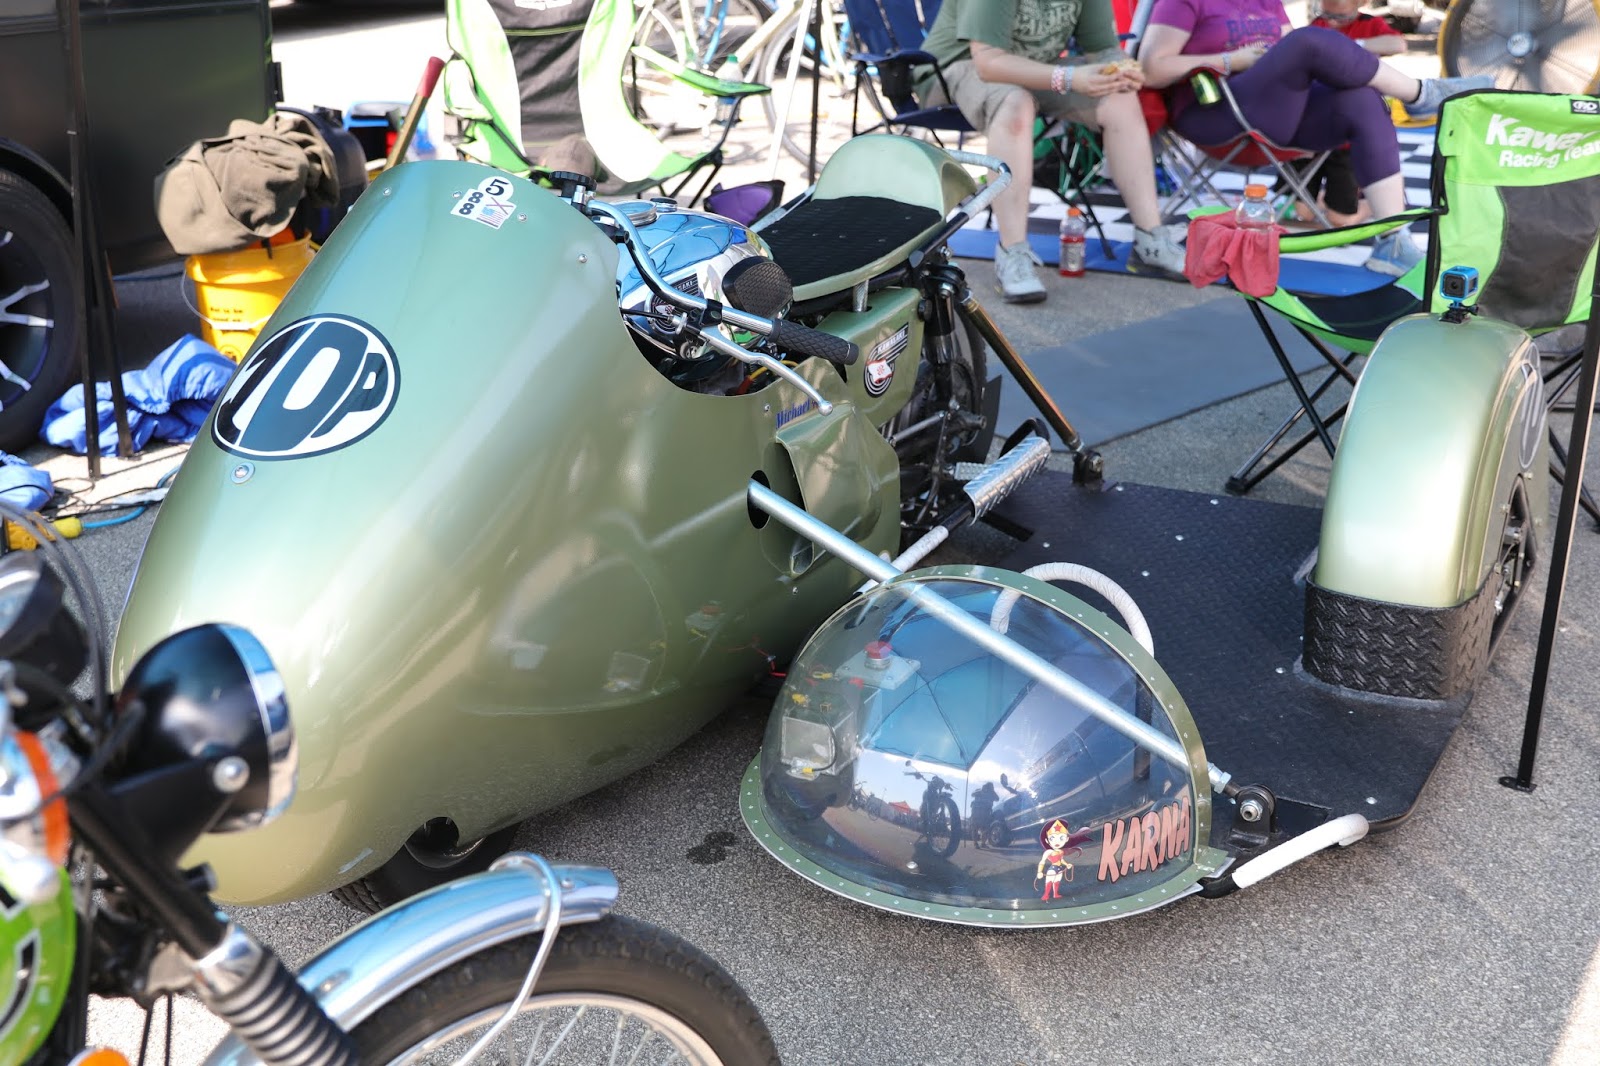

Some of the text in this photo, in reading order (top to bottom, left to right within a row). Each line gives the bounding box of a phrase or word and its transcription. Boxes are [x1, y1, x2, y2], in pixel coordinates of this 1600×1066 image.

[1499, 150, 1560, 169] Racing
[485, 178, 509, 196] 5
[775, 396, 811, 430] Michael
